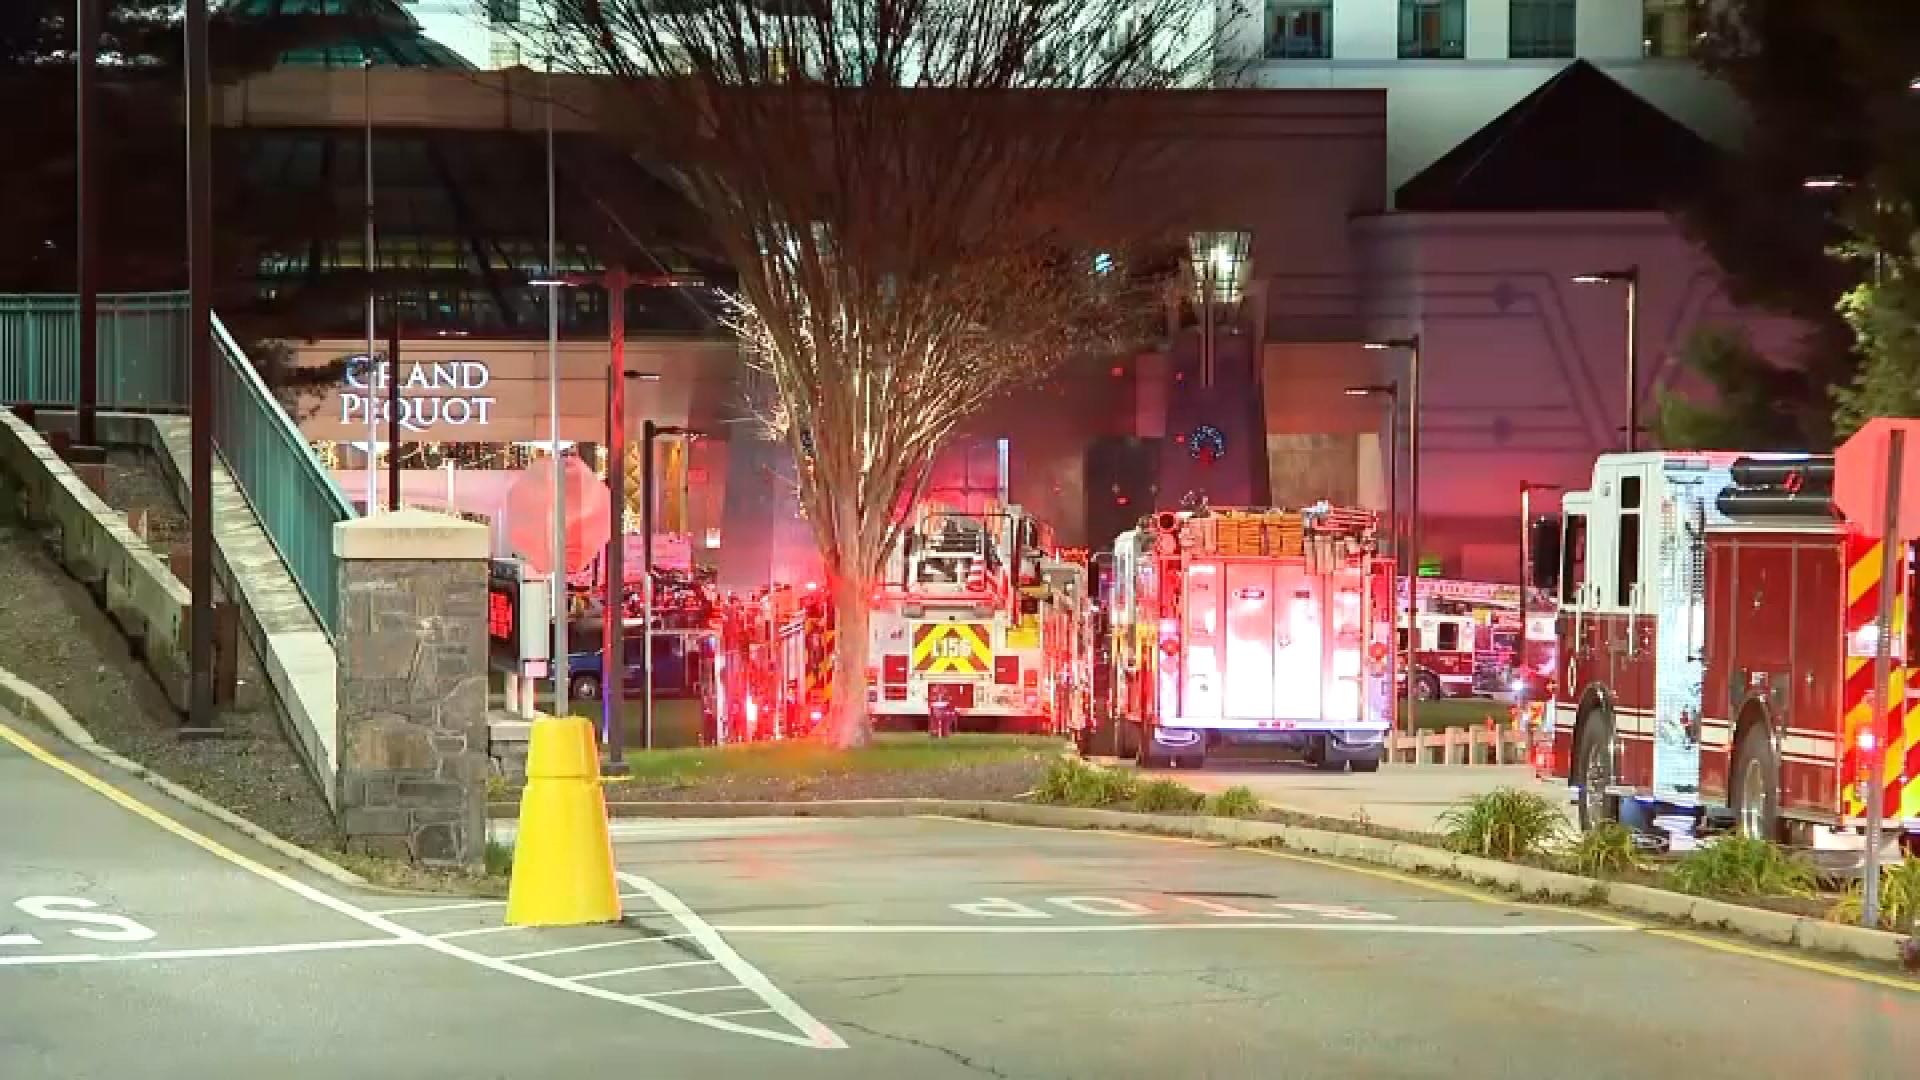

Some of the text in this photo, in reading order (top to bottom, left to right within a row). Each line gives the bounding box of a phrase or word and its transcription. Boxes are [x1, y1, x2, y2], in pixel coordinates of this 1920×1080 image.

[347, 357, 489, 389] GRAND
[339, 394, 497, 433] PEQUOT
[949, 897, 1396, 920] STOP
